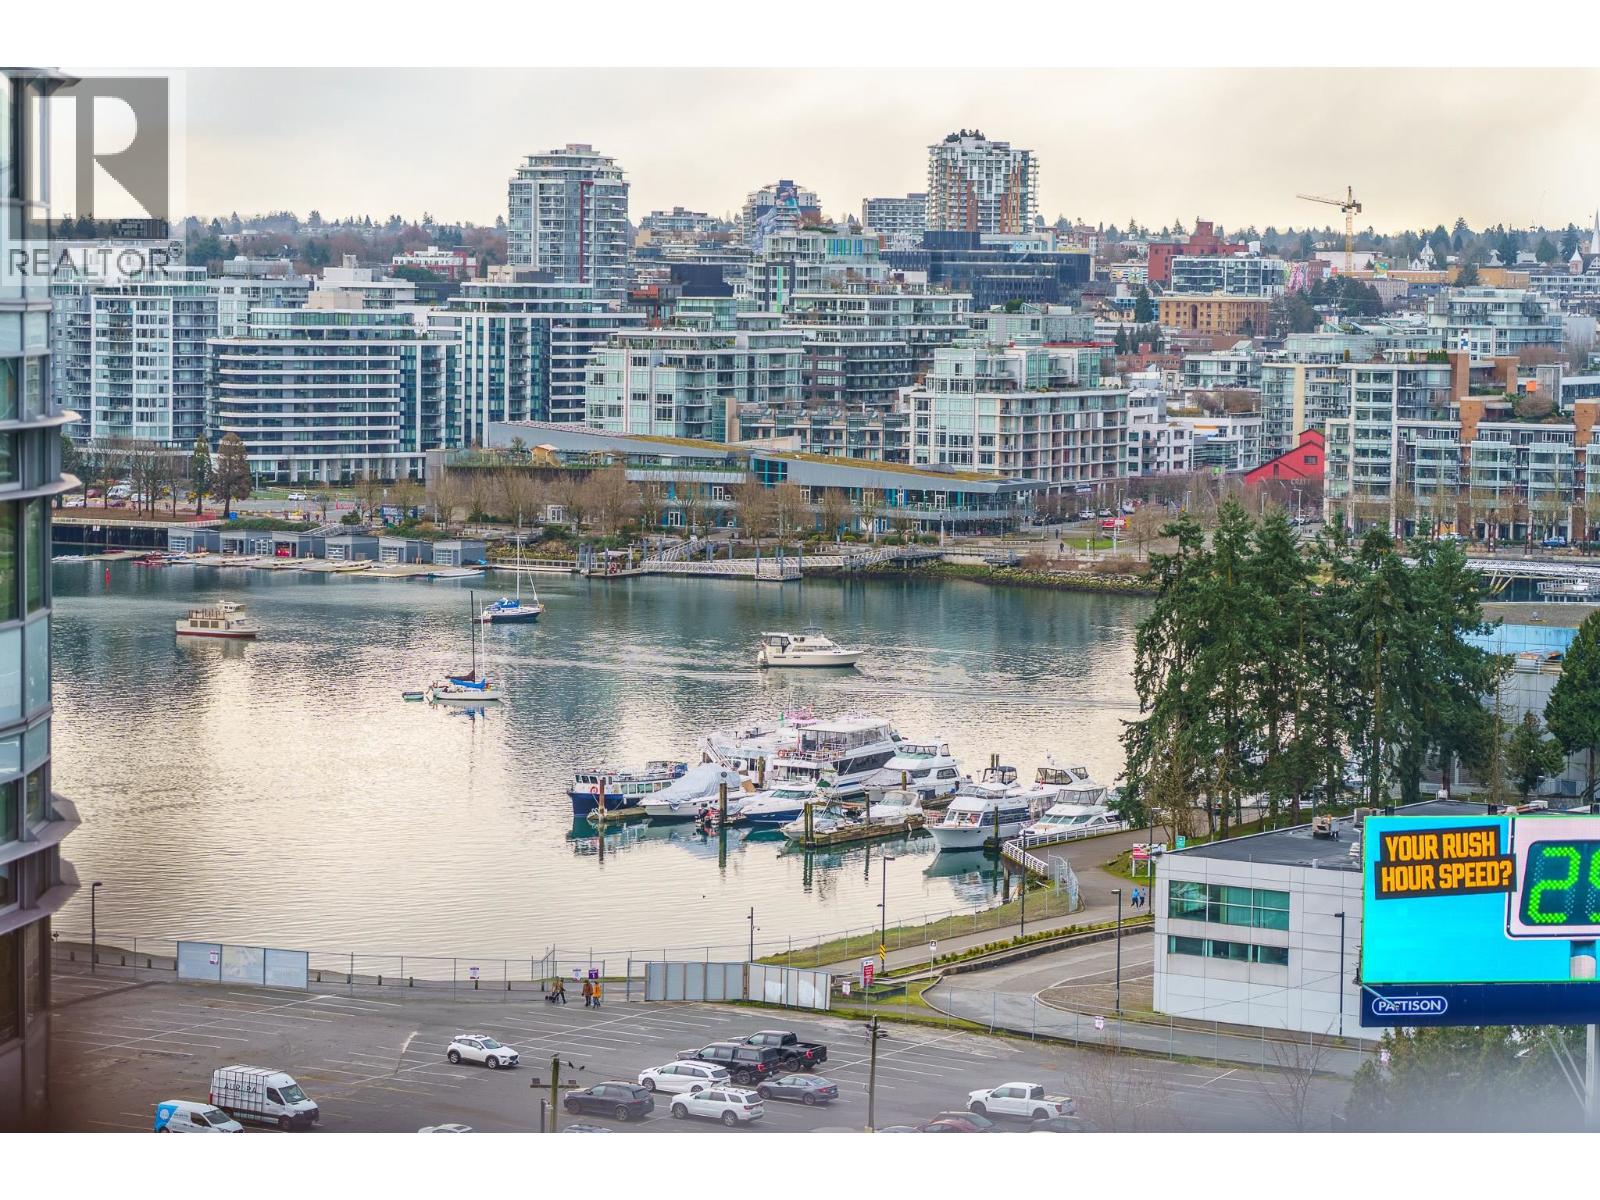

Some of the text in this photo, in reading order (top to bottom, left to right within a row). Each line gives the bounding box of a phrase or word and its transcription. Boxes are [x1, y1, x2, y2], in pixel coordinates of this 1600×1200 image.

[1385, 831, 1495, 861] YOUR RUSH
[1382, 860, 1513, 892] HOUR SPEED?
